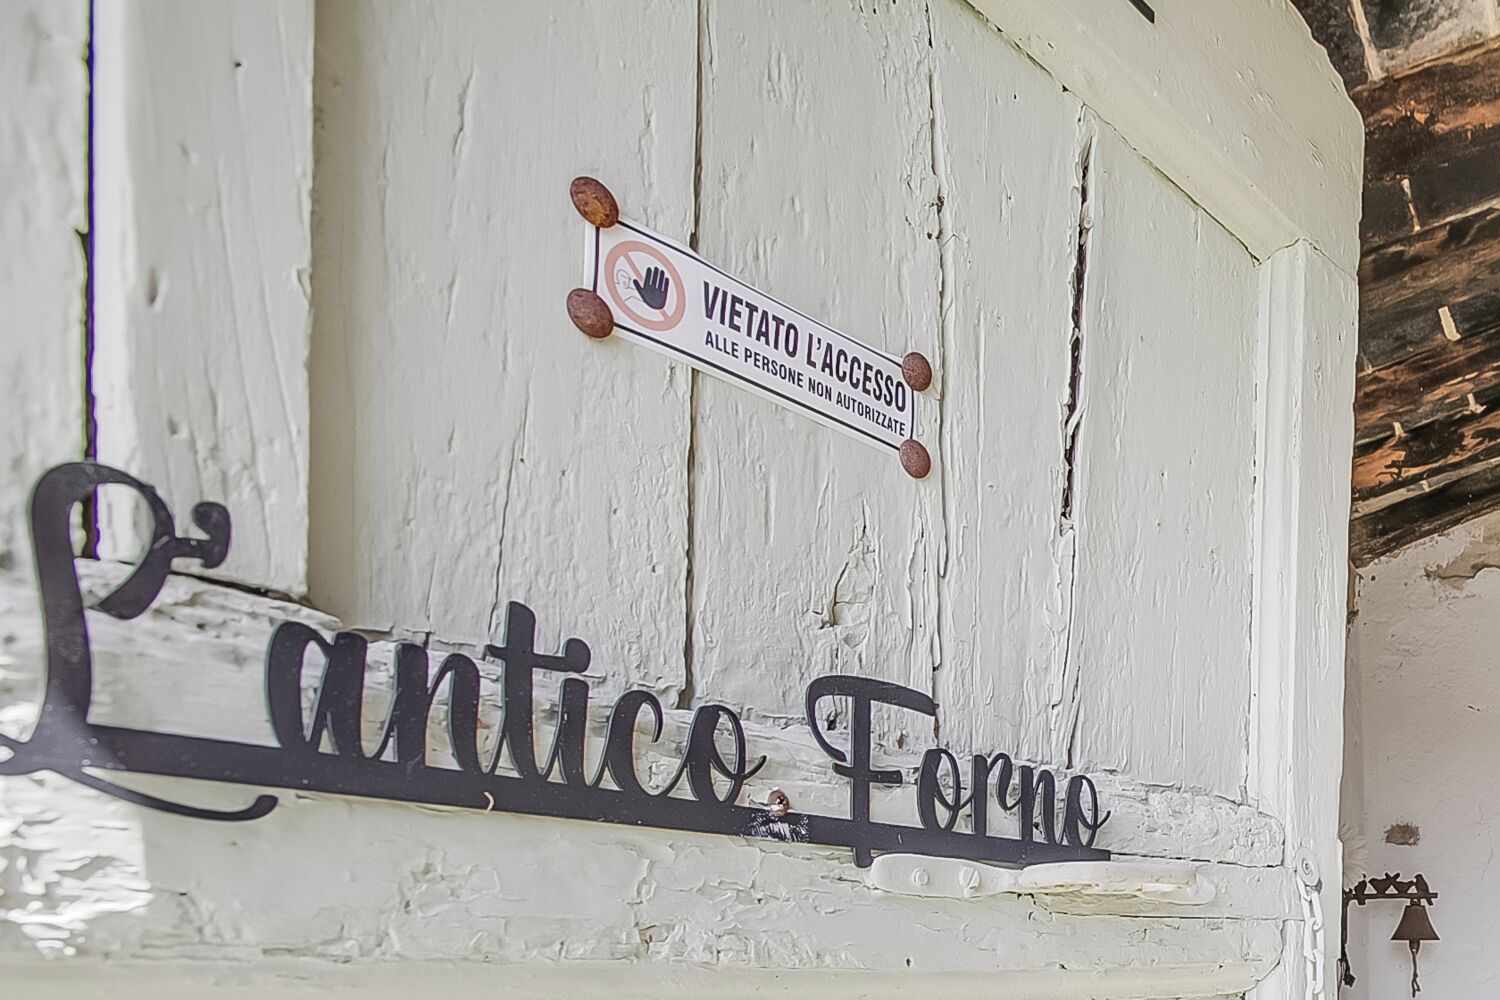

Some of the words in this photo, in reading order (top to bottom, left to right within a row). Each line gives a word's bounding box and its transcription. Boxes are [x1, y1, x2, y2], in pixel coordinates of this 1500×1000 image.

[703, 280, 800, 359] VIETATO
[805, 332, 907, 413] L'ACCESSO
[704, 330, 740, 360] ALLE
[744, 346, 805, 389] PERSONE
[808, 376, 833, 403] NON
[835, 390, 906, 437] AUTORIZZATE
[805, 674, 1111, 868] Forno
